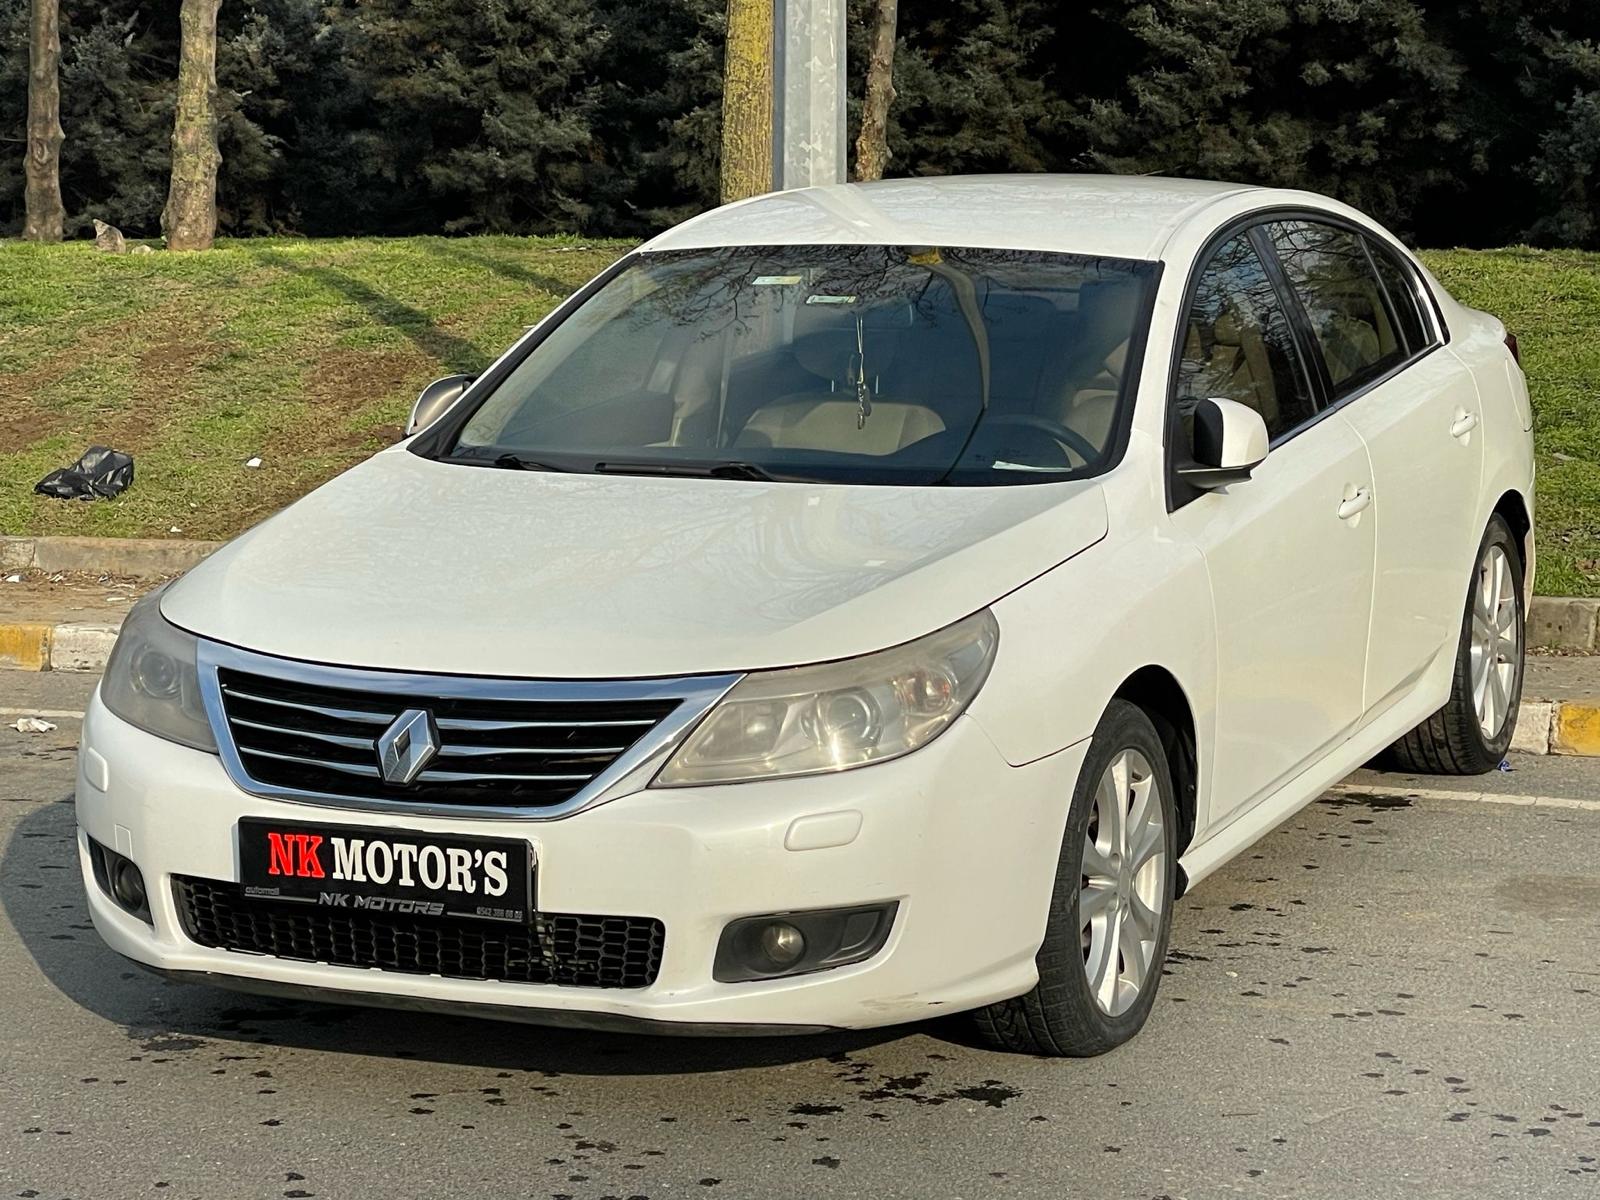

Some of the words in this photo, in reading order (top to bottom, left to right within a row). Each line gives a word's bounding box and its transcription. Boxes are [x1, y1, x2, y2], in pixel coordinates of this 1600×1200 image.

[268, 833, 325, 878] NK
[330, 837, 508, 896] MOTOR'S
[319, 892, 350, 907] NK
[353, 895, 445, 916] MOTORS
